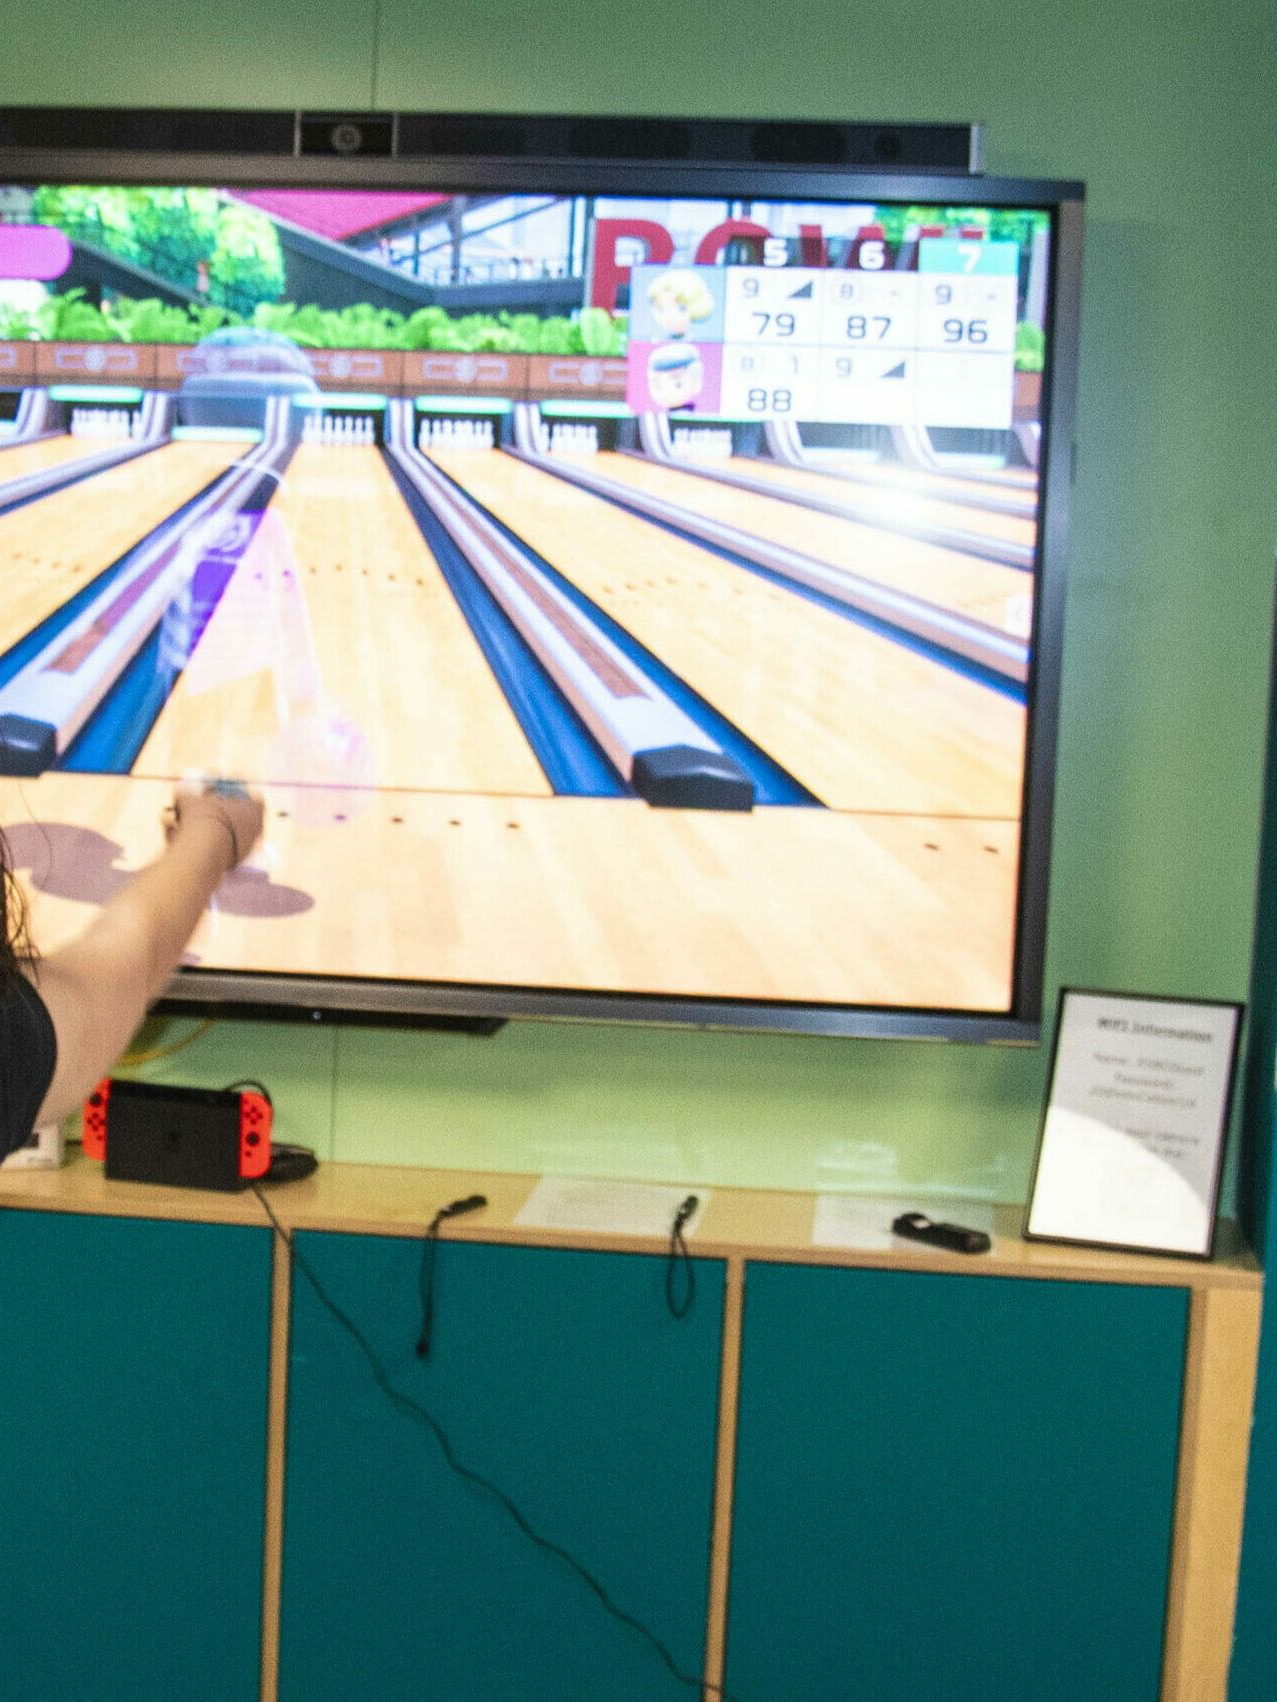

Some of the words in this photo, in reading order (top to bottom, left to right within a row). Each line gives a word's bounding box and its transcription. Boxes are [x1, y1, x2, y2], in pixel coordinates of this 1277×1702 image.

[762, 237, 789, 268] 5
[858, 240, 886, 271] 6
[956, 243, 983, 273] 7
[741, 277, 761, 299] 9
[934, 283, 953, 305] 9
[751, 311, 796, 338] 79
[846, 314, 892, 341] 87
[942, 318, 989, 345] 96
[746, 387, 793, 412] 88
